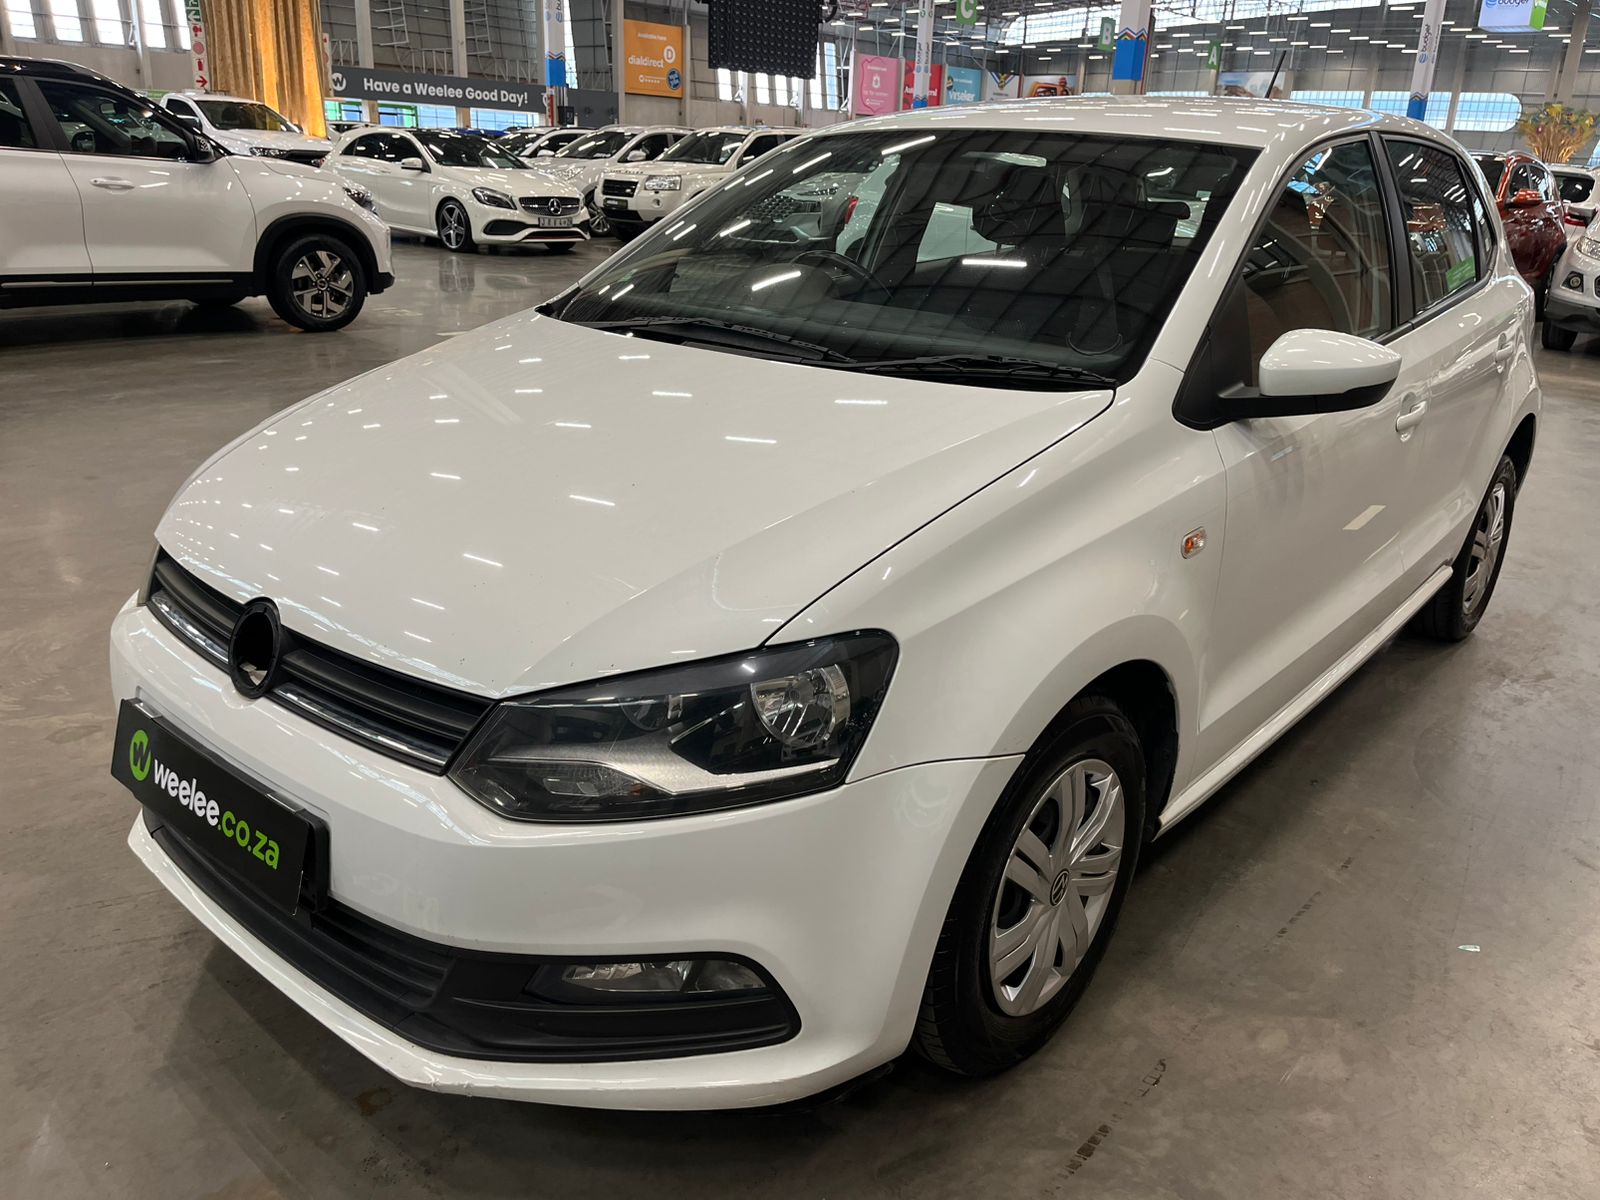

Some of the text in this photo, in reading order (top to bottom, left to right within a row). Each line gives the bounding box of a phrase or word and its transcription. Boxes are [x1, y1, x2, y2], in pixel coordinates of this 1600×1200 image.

[961, 0, 974, 18] C
[1102, 22, 1112, 45] B
[628, 55, 664, 68] dialdirect
[1208, 46, 1217, 65] A
[363, 77, 528, 107] Have a Weelee Good Day!
[154, 758, 280, 870] weelee.co.za
